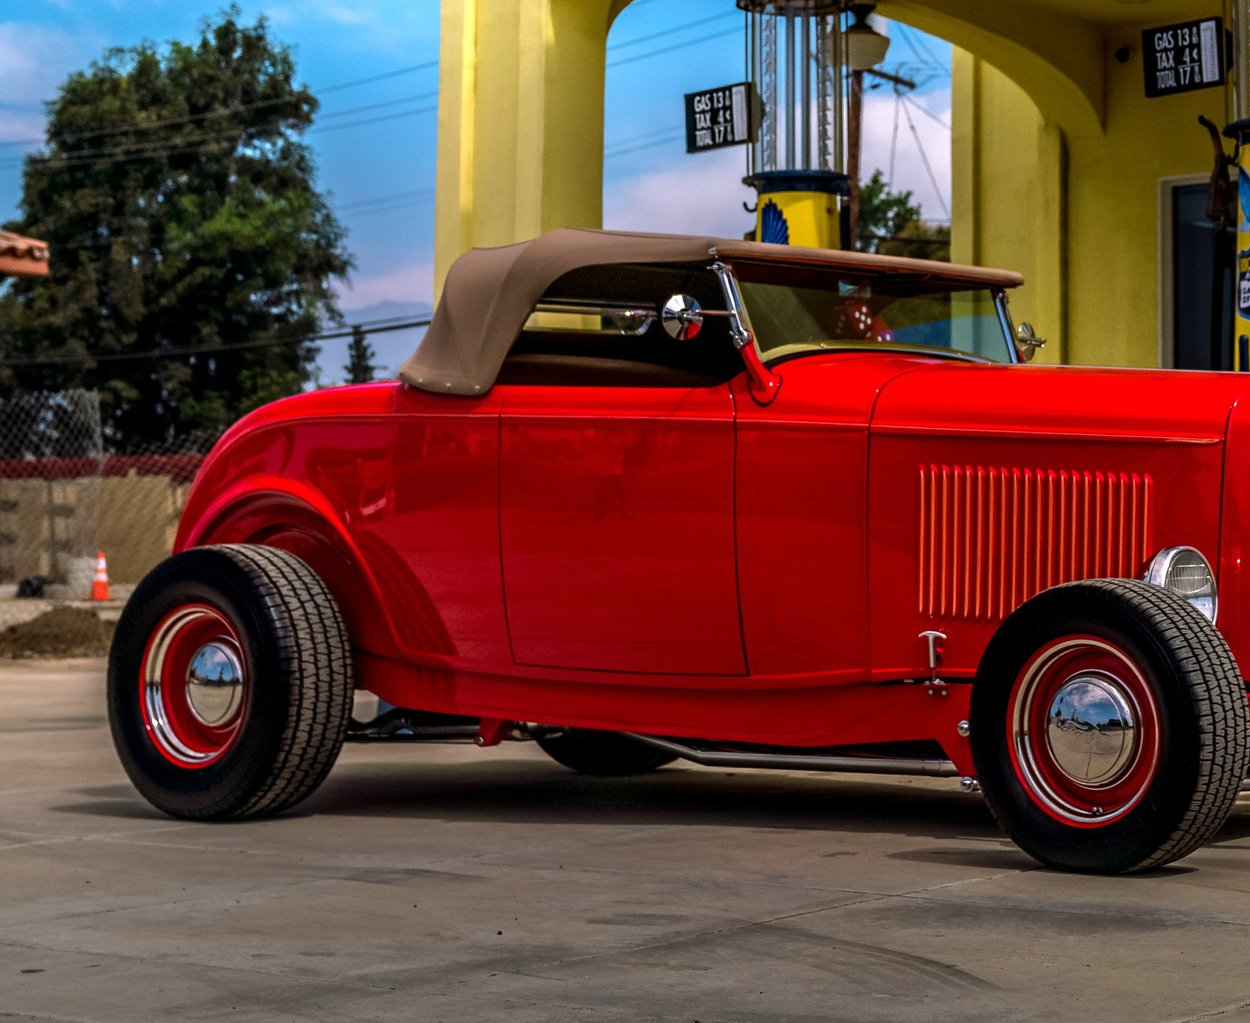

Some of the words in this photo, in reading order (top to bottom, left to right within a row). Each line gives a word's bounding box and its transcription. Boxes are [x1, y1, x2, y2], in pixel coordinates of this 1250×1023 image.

[1154, 30, 1175, 51] GAS
[1155, 50, 1175, 69] TAX
[1156, 69, 1177, 89] TOTAL
[1178, 66, 1191, 85] 17
[694, 93, 711, 112] GAS
[695, 111, 712, 130] TAX
[1242, 294, 1250, 304] OF
